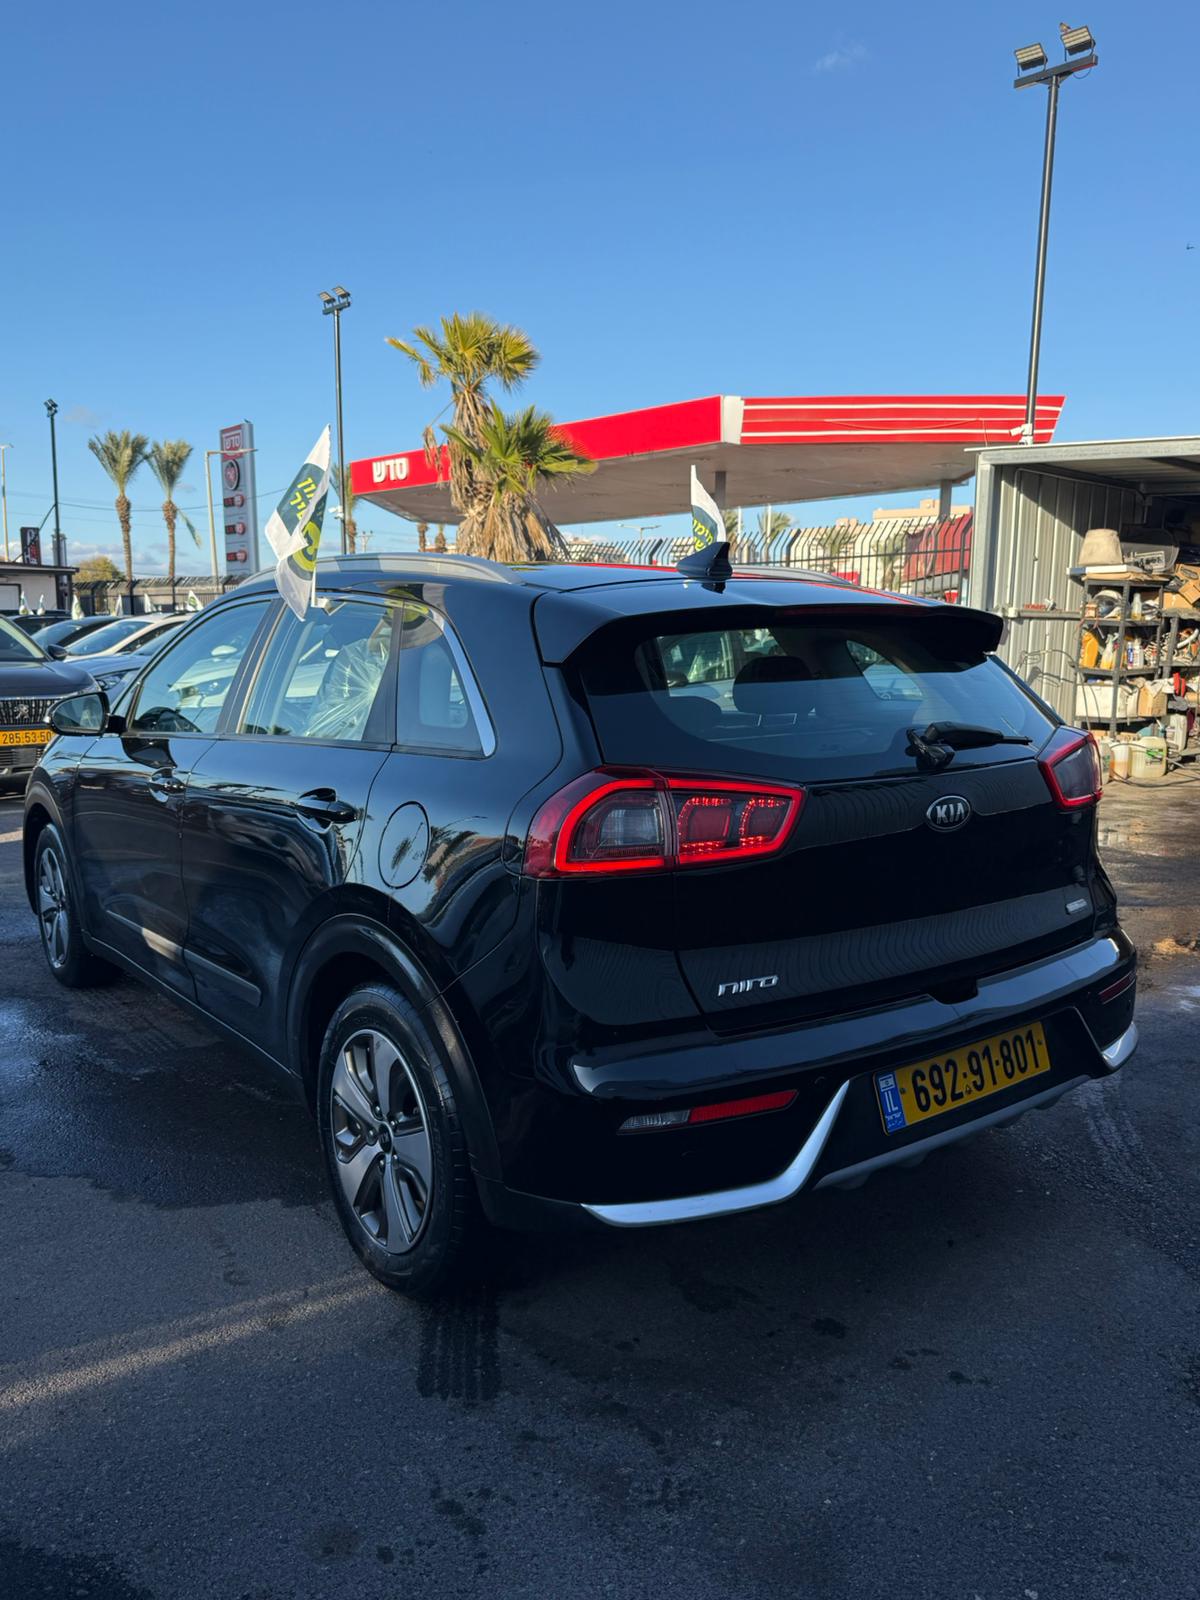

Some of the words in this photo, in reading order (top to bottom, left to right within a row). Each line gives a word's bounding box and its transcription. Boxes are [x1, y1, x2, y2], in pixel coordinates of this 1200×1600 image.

[372, 457, 409, 483] סדש
[936, 802, 965, 824] KIA
[884, 1090, 898, 1112] IL
